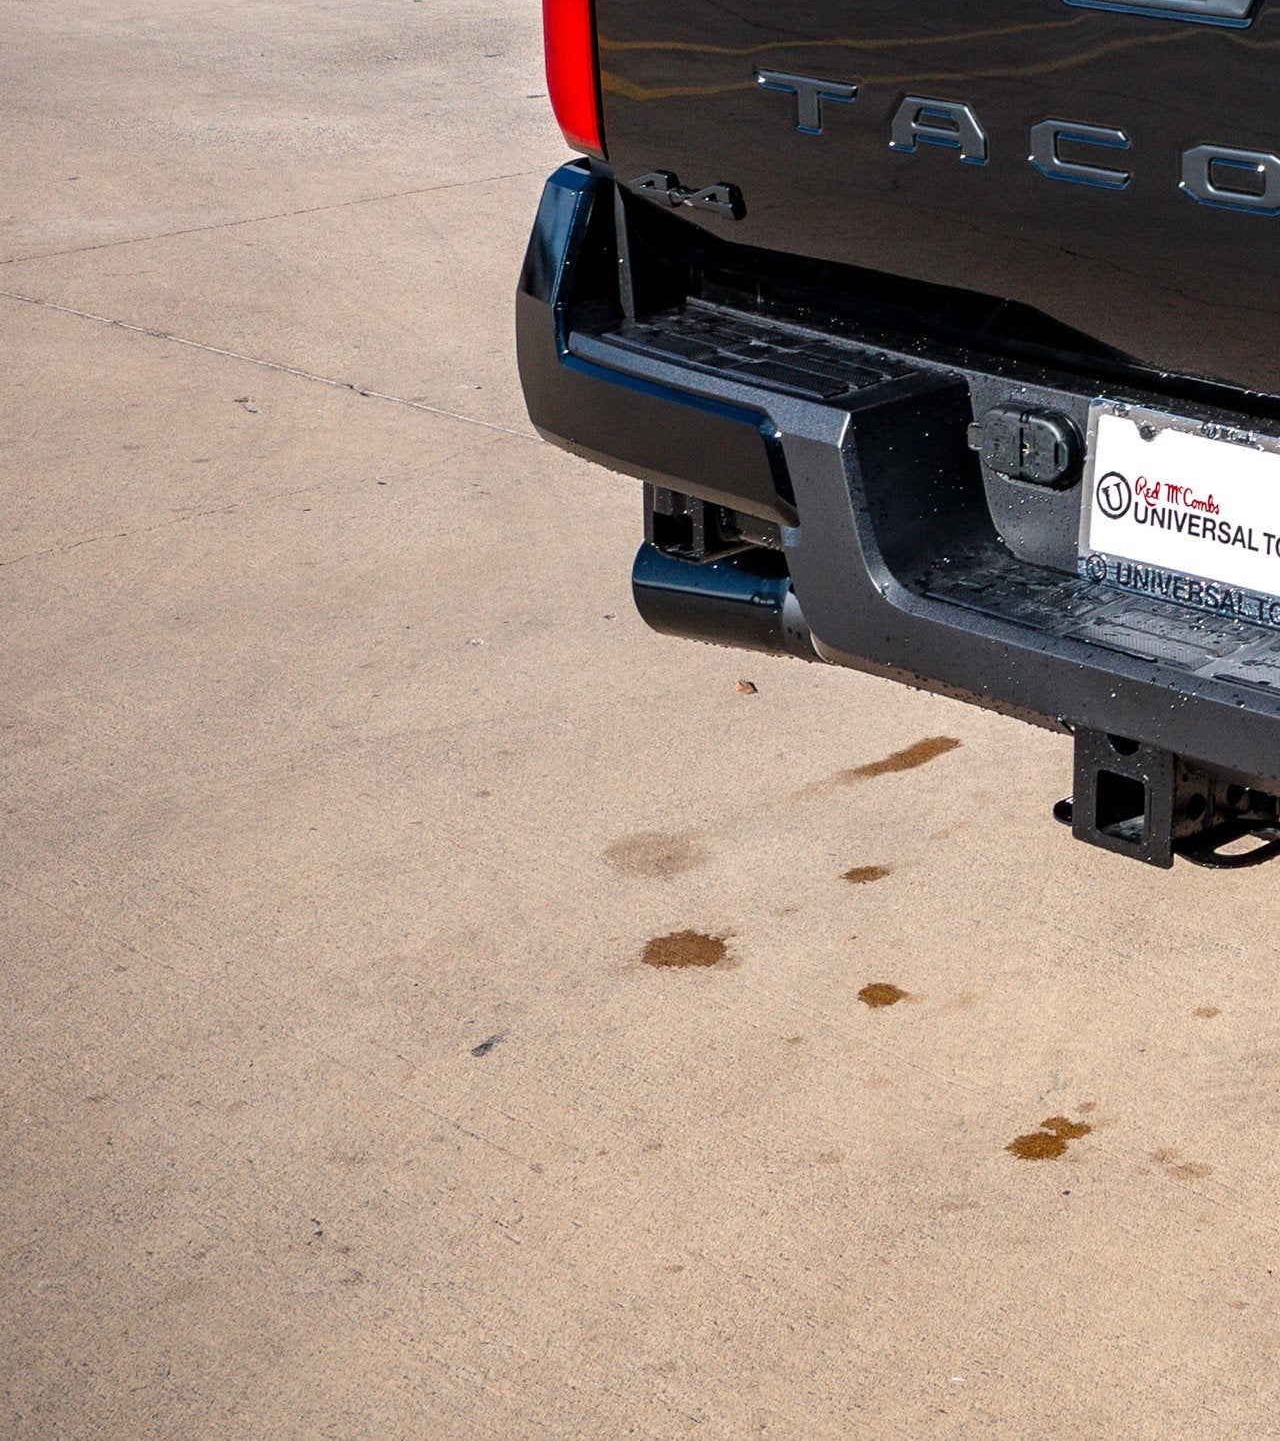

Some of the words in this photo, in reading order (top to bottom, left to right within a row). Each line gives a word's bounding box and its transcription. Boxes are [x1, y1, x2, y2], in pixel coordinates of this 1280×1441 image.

[1135, 475, 1161, 507] Red
[1133, 501, 1259, 553] UNIVERSAL
[1116, 561, 1247, 617] UNIVERSAL
